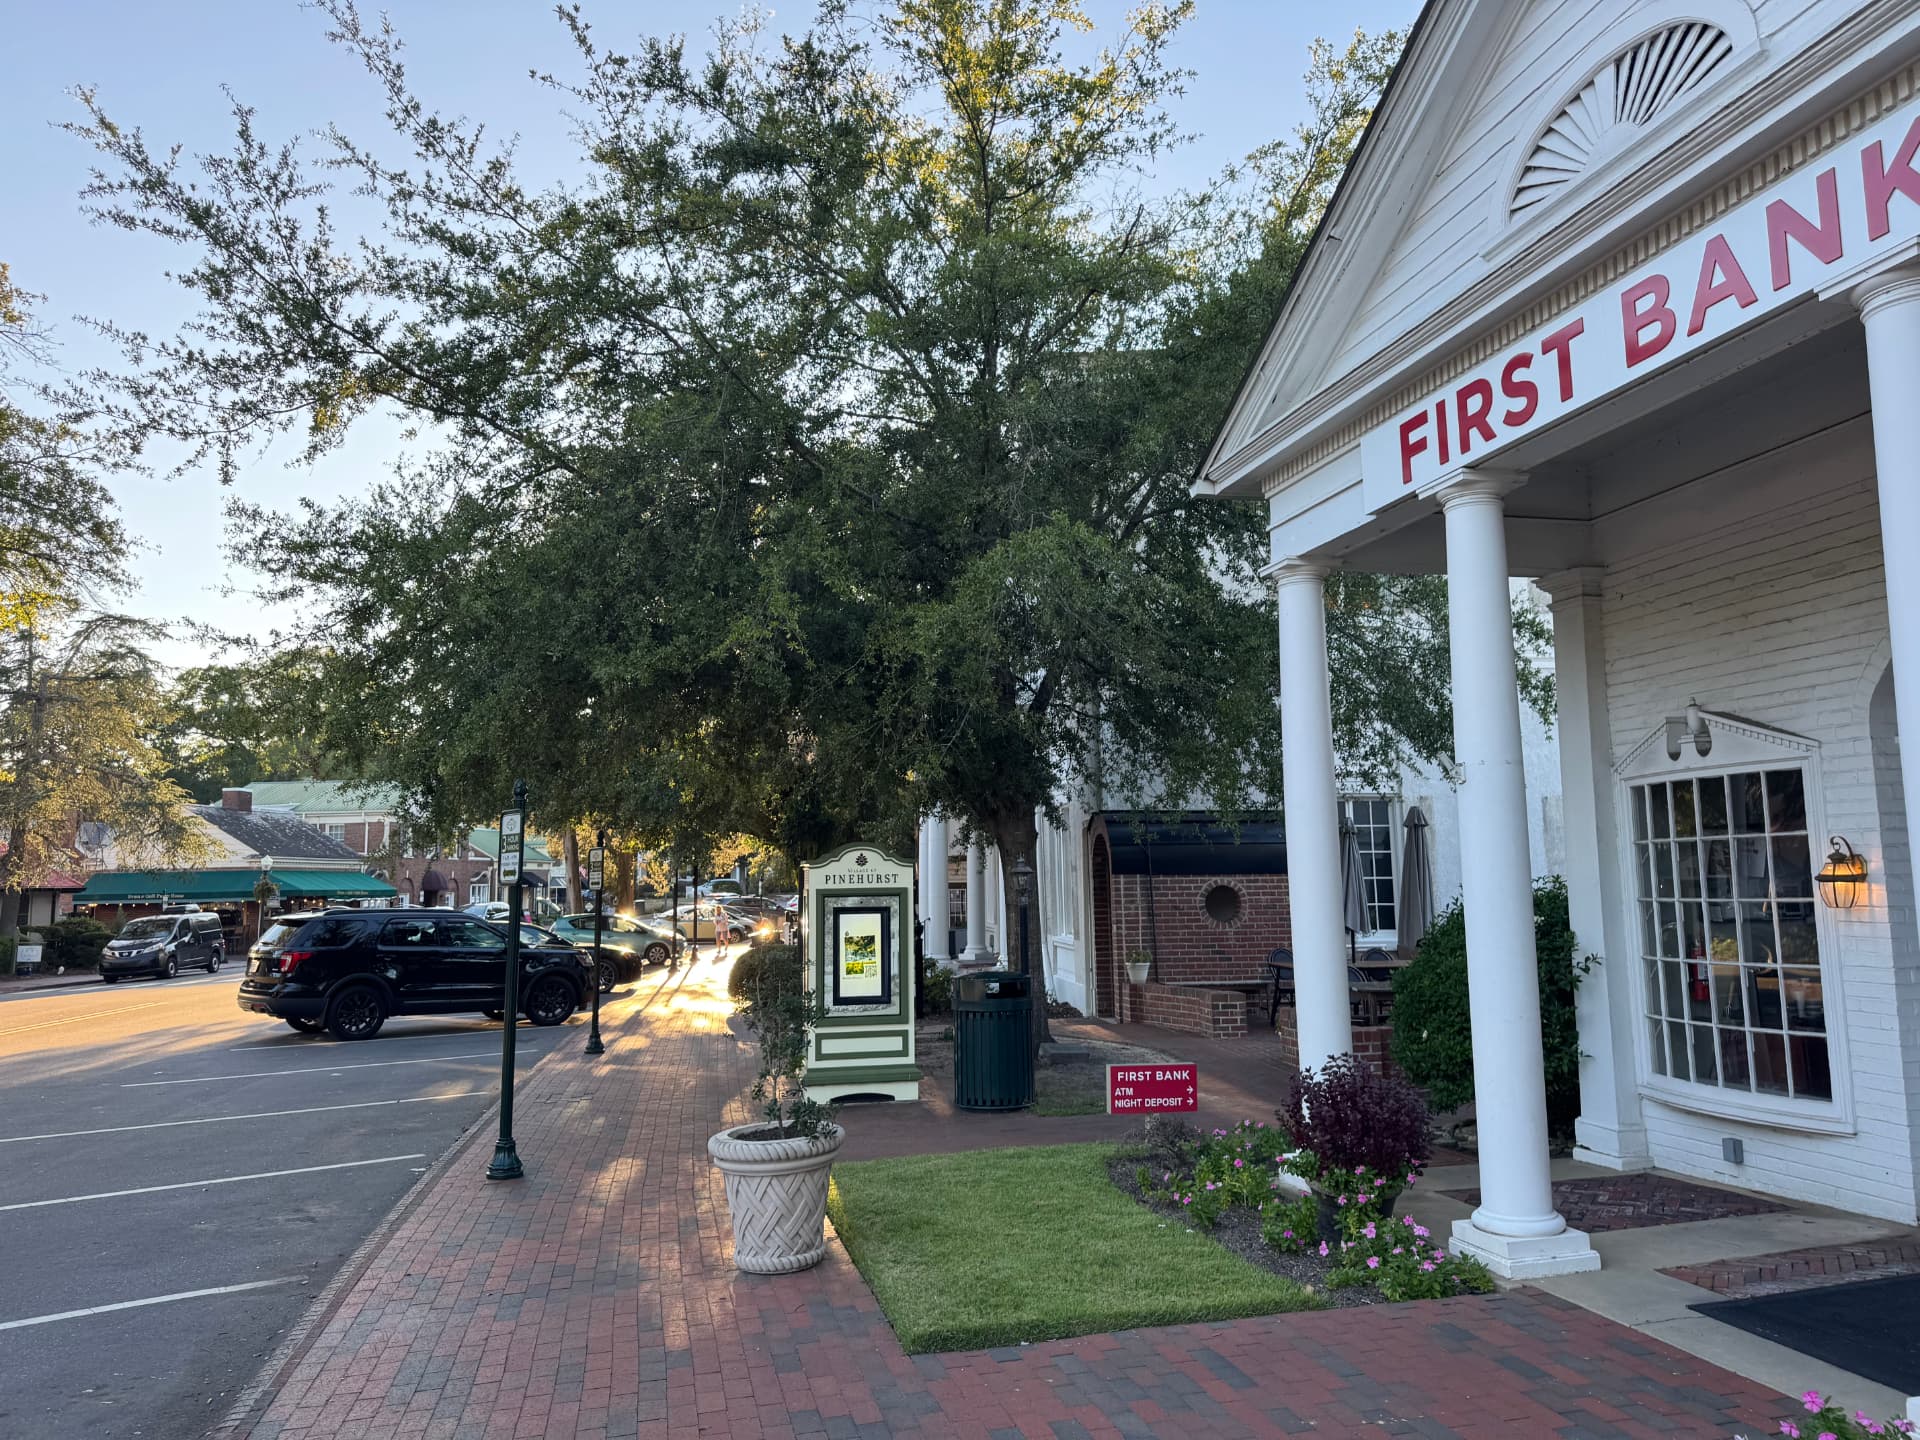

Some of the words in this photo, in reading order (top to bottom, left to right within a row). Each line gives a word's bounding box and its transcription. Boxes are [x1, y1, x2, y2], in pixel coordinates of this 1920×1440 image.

[1399, 316, 1584, 485] FIRST
[1620, 112, 1920, 368] BANK
[825, 874, 899, 884] PINEHURST
[1117, 1071, 1151, 1082] FIRST
[1156, 1070, 1190, 1080] BANK
[1115, 1087, 1134, 1096] ATM
[1115, 1099, 1142, 1108] NIGHT
[1145, 1097, 1182, 1107] DEPOSIT
